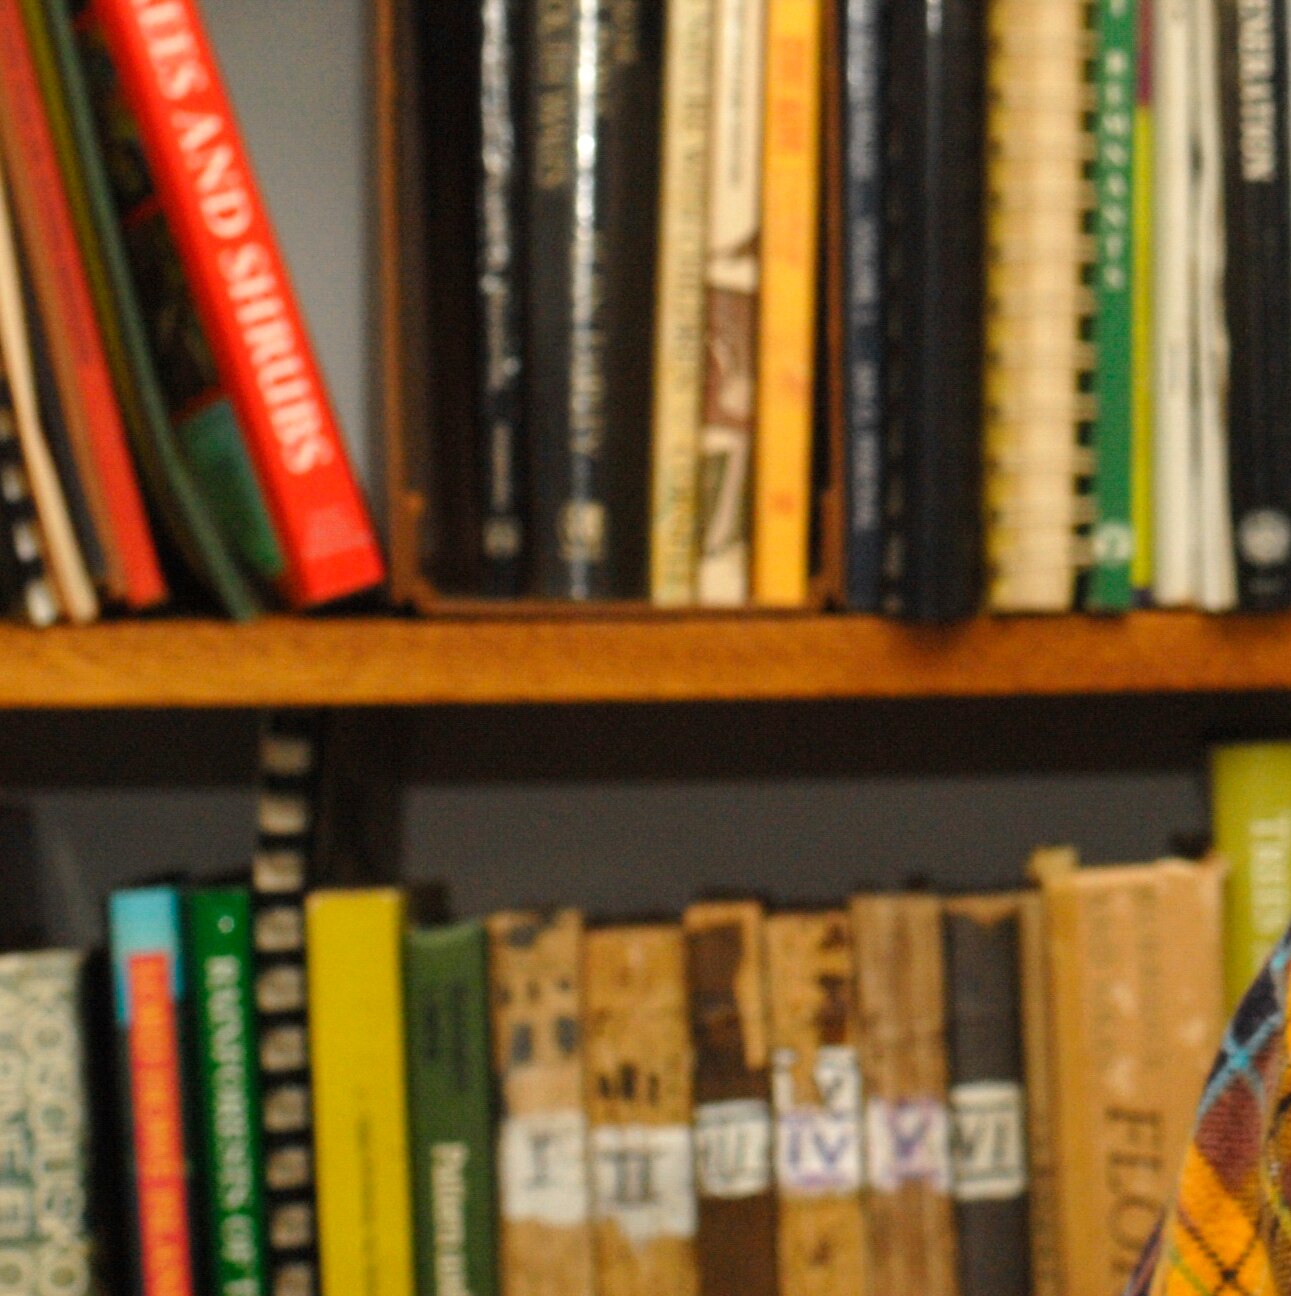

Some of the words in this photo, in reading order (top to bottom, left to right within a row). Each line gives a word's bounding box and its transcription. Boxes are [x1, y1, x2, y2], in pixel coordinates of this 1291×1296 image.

[169, 108, 254, 240] AND
[218, 243, 338, 477] SHRUBS
[1100, 51, 1130, 291] REMNANTS
[205, 955, 257, 1206] RAINFORESTS
